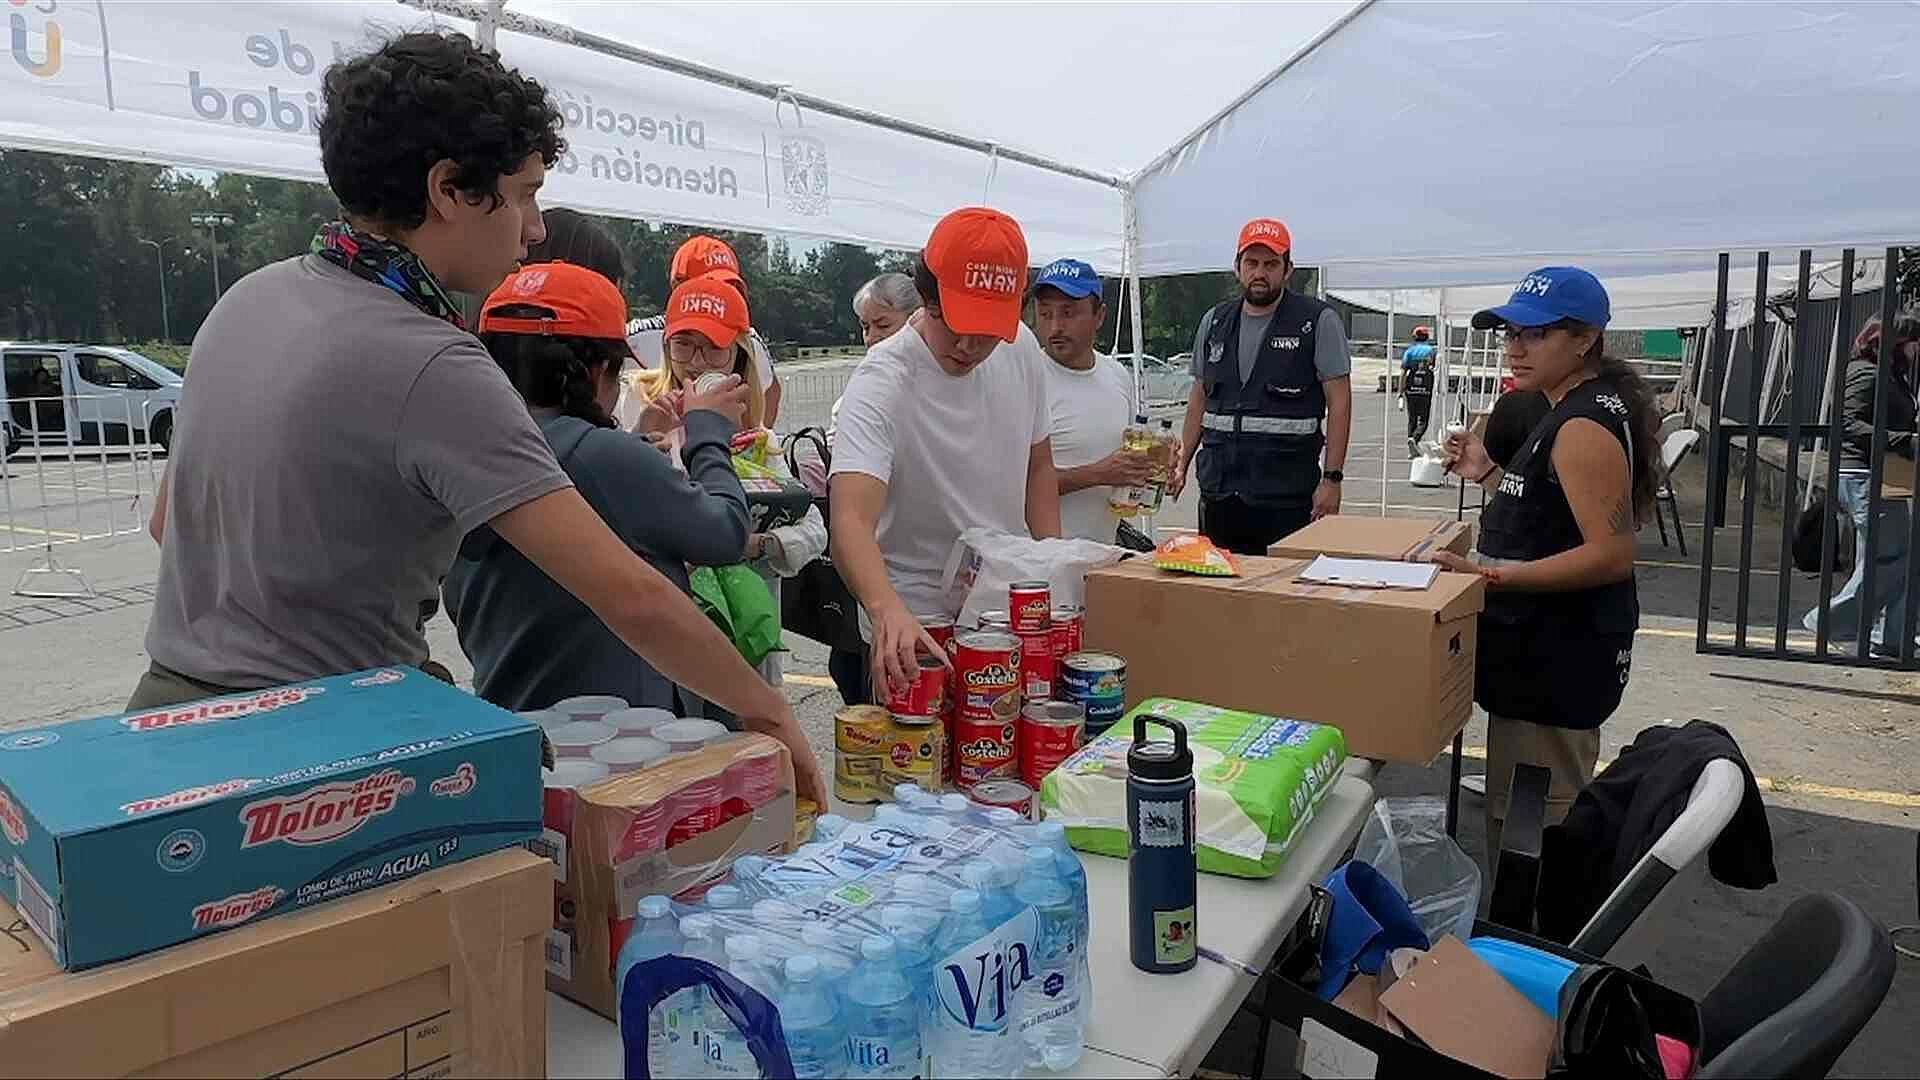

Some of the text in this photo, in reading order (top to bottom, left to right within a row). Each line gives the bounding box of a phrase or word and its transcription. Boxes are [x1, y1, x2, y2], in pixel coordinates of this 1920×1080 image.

[965, 271, 1017, 293] UNAM
[1043, 263, 1080, 279] UNAM
[681, 297, 726, 319] UNAM
[246, 788, 395, 844] Dolores
[378, 851, 430, 880] AGUA
